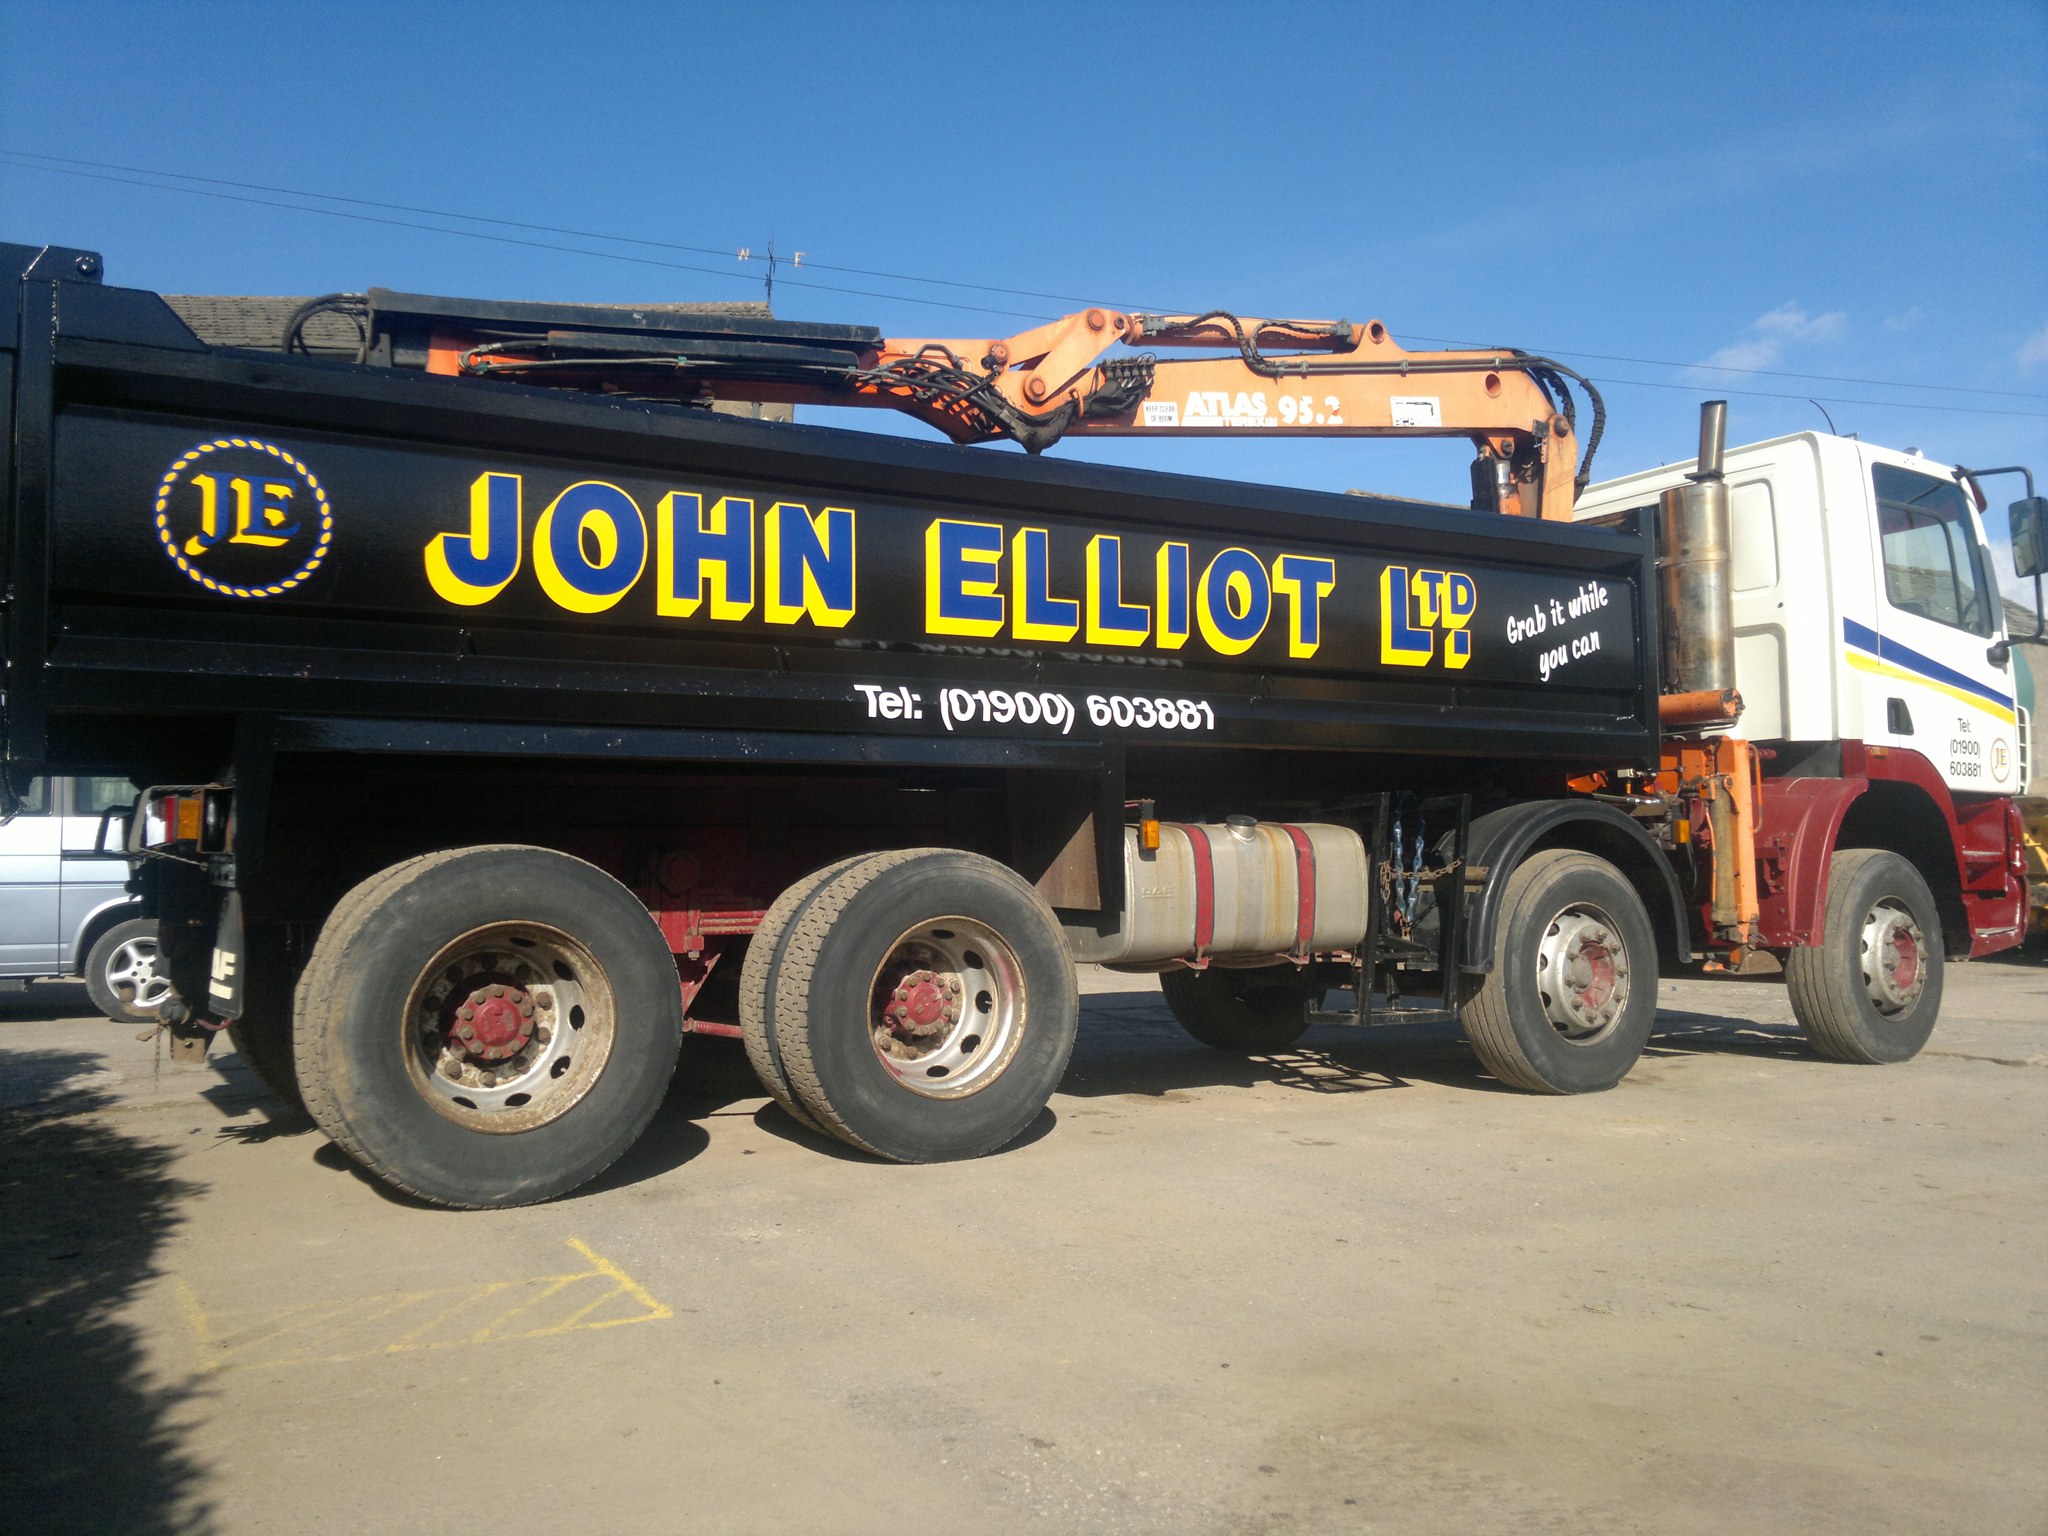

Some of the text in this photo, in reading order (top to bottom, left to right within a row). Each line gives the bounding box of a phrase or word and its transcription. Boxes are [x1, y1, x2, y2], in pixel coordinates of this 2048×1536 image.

[1184, 391, 1344, 425] ATLAS 95.2
[184, 471, 300, 556] JE
[424, 471, 856, 628] JOHN
[925, 518, 1336, 659] ELLIOT
[1506, 580, 1608, 644] Grab it while
[1539, 631, 1601, 682] you can
[853, 684, 1215, 734] Tel: (01900) 603881
[1949, 739, 1981, 759] (01900)
[1949, 761, 1982, 777] 603881
